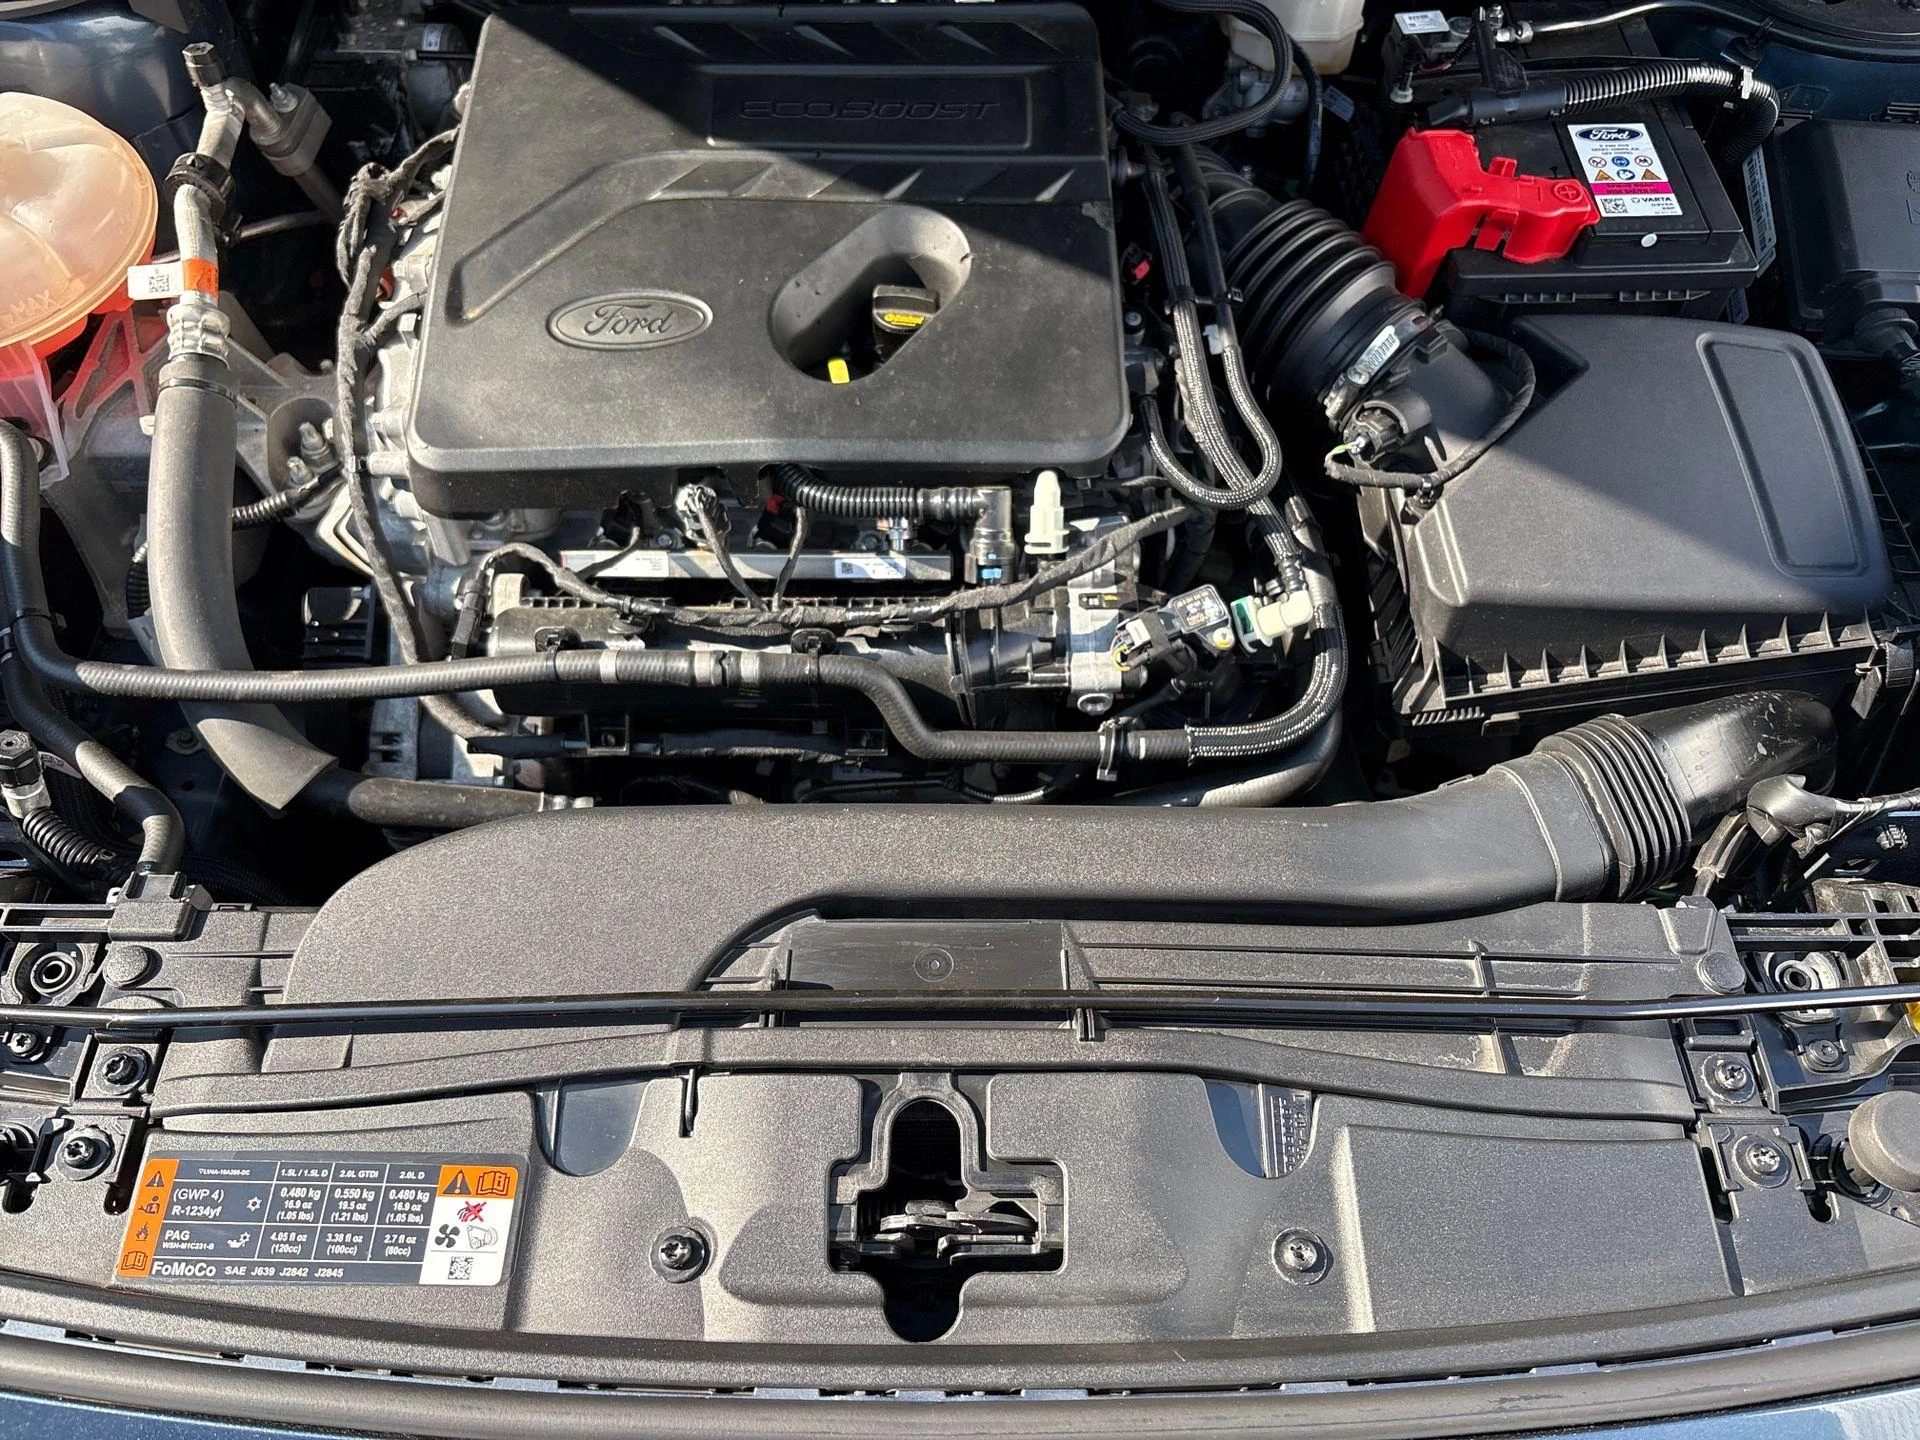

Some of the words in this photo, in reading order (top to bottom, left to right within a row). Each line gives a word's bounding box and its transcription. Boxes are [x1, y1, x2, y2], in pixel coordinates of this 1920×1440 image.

[738, 100, 1001, 121] ECOBOOST
[1589, 129, 1631, 140] Ford
[584, 303, 675, 336] Ford
[281, 1168, 298, 1177] 1.5L
[304, 1169, 320, 1177] 1.5L
[321, 1169, 328, 1177] D
[339, 1169, 357, 1178] 2.0L
[399, 1171, 417, 1179] 2.0L
[418, 1171, 425, 1179] D
[173, 1188, 210, 1202] (GWP
[211, 1189, 224, 1203] 4)
[280, 1187, 306, 1198] 0.480
[308, 1189, 322, 1200] kg
[334, 1188, 361, 1199] 0.550
[362, 1190, 375, 1202] kg
[388, 1189, 415, 1201] 0.480
[416, 1191, 430, 1203] kg
[284, 1199, 301, 1209] 16.9
[302, 1201, 313, 1209] oz
[338, 1201, 356, 1210] 19.5
[356, 1202, 367, 1210] oz
[393, 1202, 410, 1211] 16.9
[411, 1203, 422, 1211] oz
[171, 1205, 223, 1219] R-1234yf
[299, 1211, 314, 1222] lbs)
[330, 1212, 350, 1223] (1.21
[351, 1212, 369, 1223] lbs)
[407, 1213, 424, 1225] lbs)
[165, 1230, 190, 1240] PAG
[270, 1232, 289, 1241] 4.05
[296, 1233, 308, 1242] oz
[326, 1233, 345, 1242] 3.38
[352, 1234, 363, 1243] oz
[384, 1234, 397, 1243] 2.7
[405, 1235, 417, 1244] oz
[270, 1244, 302, 1255] (120cc)
[327, 1245, 358, 1256] (100cc)
[385, 1246, 412, 1257] (80cc)
[151, 1261, 217, 1277] FoMoCo
[224, 1266, 247, 1276] SAE
[251, 1266, 276, 1276] J639
[279, 1267, 309, 1277] J2842
[314, 1268, 344, 1277] J2845
